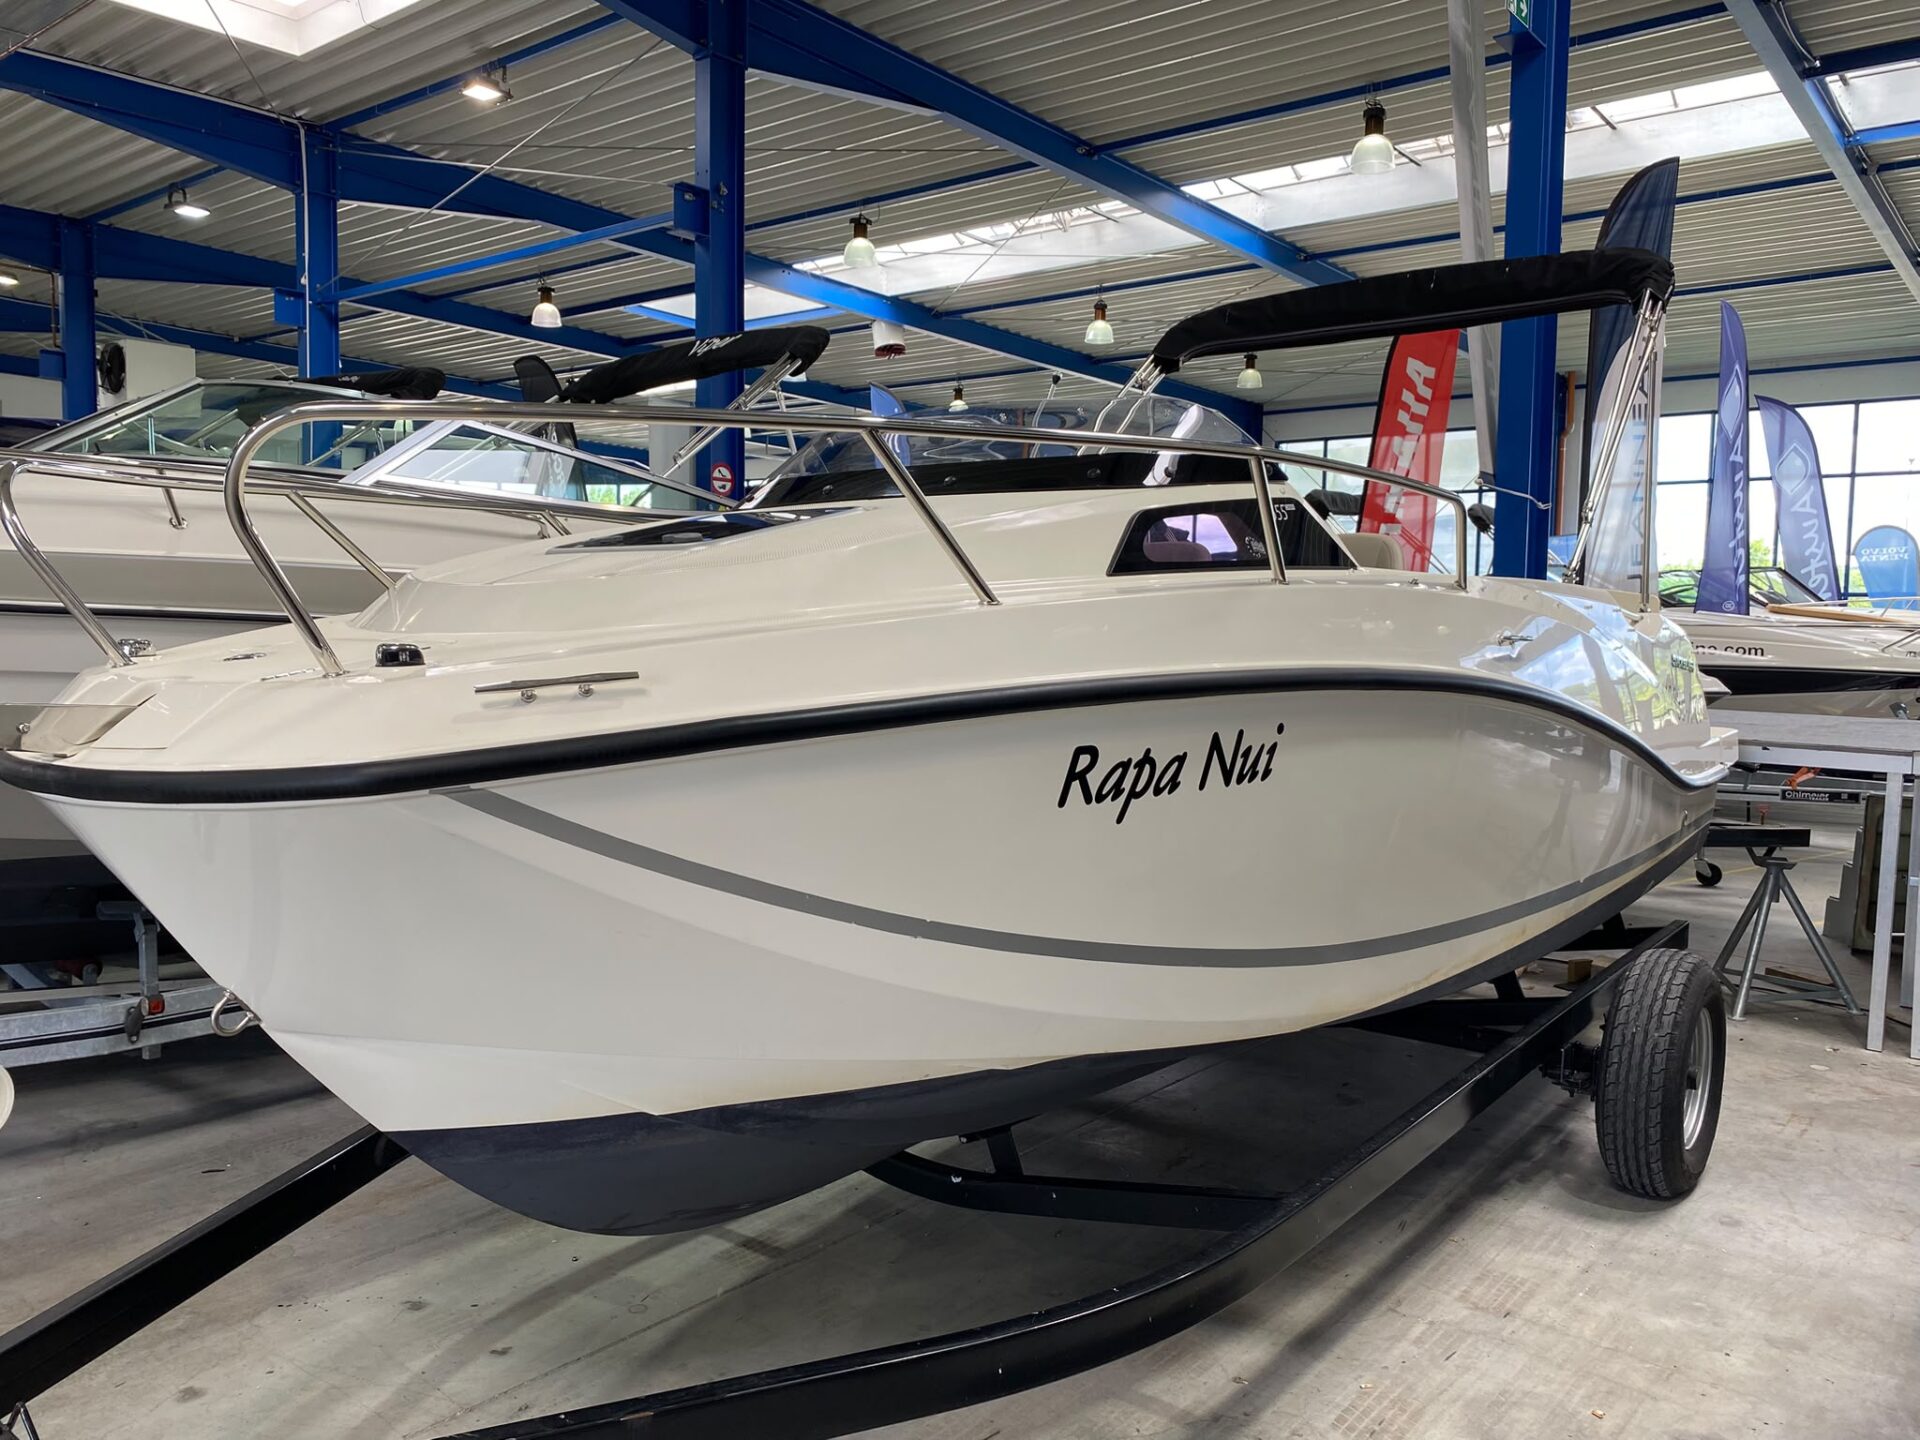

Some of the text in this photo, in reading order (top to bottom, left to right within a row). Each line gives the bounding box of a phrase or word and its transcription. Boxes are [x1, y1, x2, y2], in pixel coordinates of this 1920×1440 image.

[1273, 503, 1289, 521] 55
[1057, 722, 1285, 825] Rapa Nui
